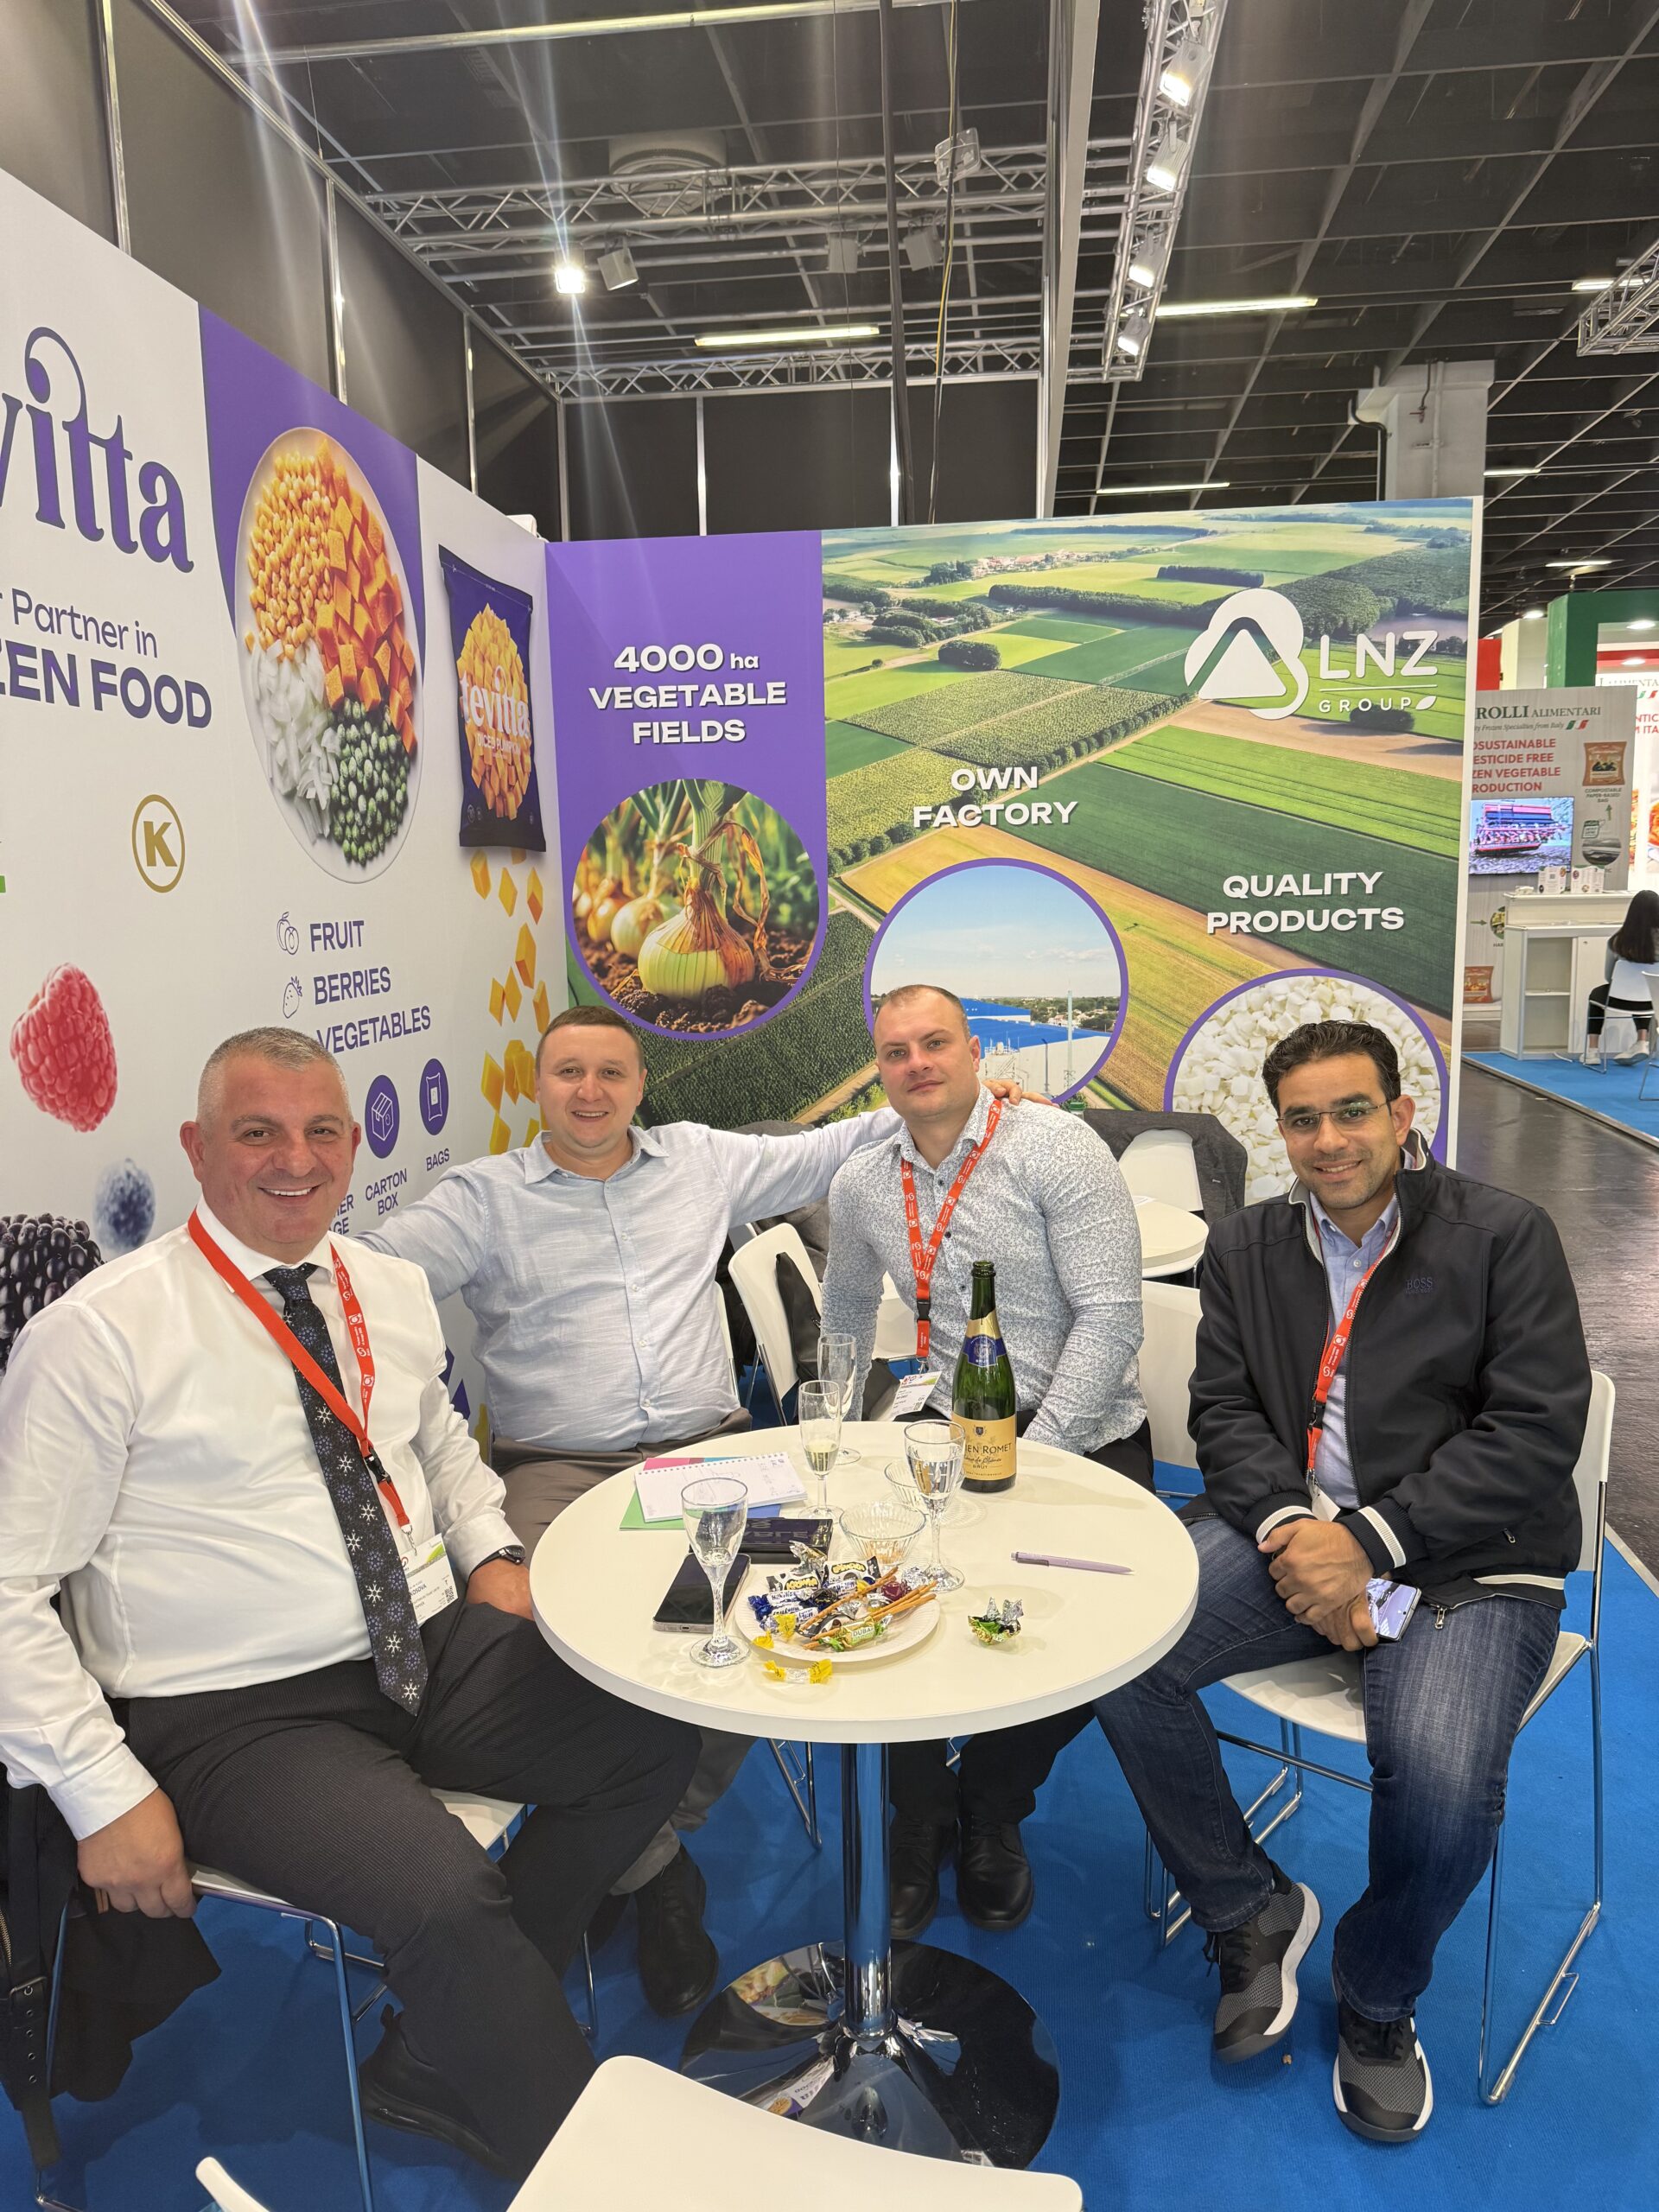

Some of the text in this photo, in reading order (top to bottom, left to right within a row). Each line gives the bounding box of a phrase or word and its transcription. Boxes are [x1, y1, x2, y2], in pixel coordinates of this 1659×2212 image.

[12, 588, 158, 658] Partner in
[613, 643, 760, 673] 4000 ha
[1319, 630, 1439, 679] LNZ
[0, 638, 213, 728] EN FOOD
[588, 682, 787, 710] VEGETABLE
[460, 665, 530, 741] tevitta
[1319, 696, 1411, 713] GROUP
[1474, 705, 1601, 720] ROLLI ALIMENTARI
[632, 719, 746, 745] FIELDS
[1526, 753, 1554, 762] FREE
[950, 766, 1038, 791] OWN
[1496, 766, 1560, 778] VEGETABLE
[912, 801, 1078, 829] FACTORY
[1223, 871, 1383, 899] QUALITY
[1206, 906, 1405, 934] PRODUCTS
[309, 920, 365, 951] FRUIT
[313, 966, 391, 1005] BERRIES
[316, 1005, 431, 1053] VEGETABLES
[426, 1147, 450, 1172] BAGS
[365, 1167, 408, 1201] CARTON
[378, 1192, 398, 1216] BOX
[1407, 1276, 1433, 1289] BOSS
[982, 1442, 1012, 1453] ROMET
